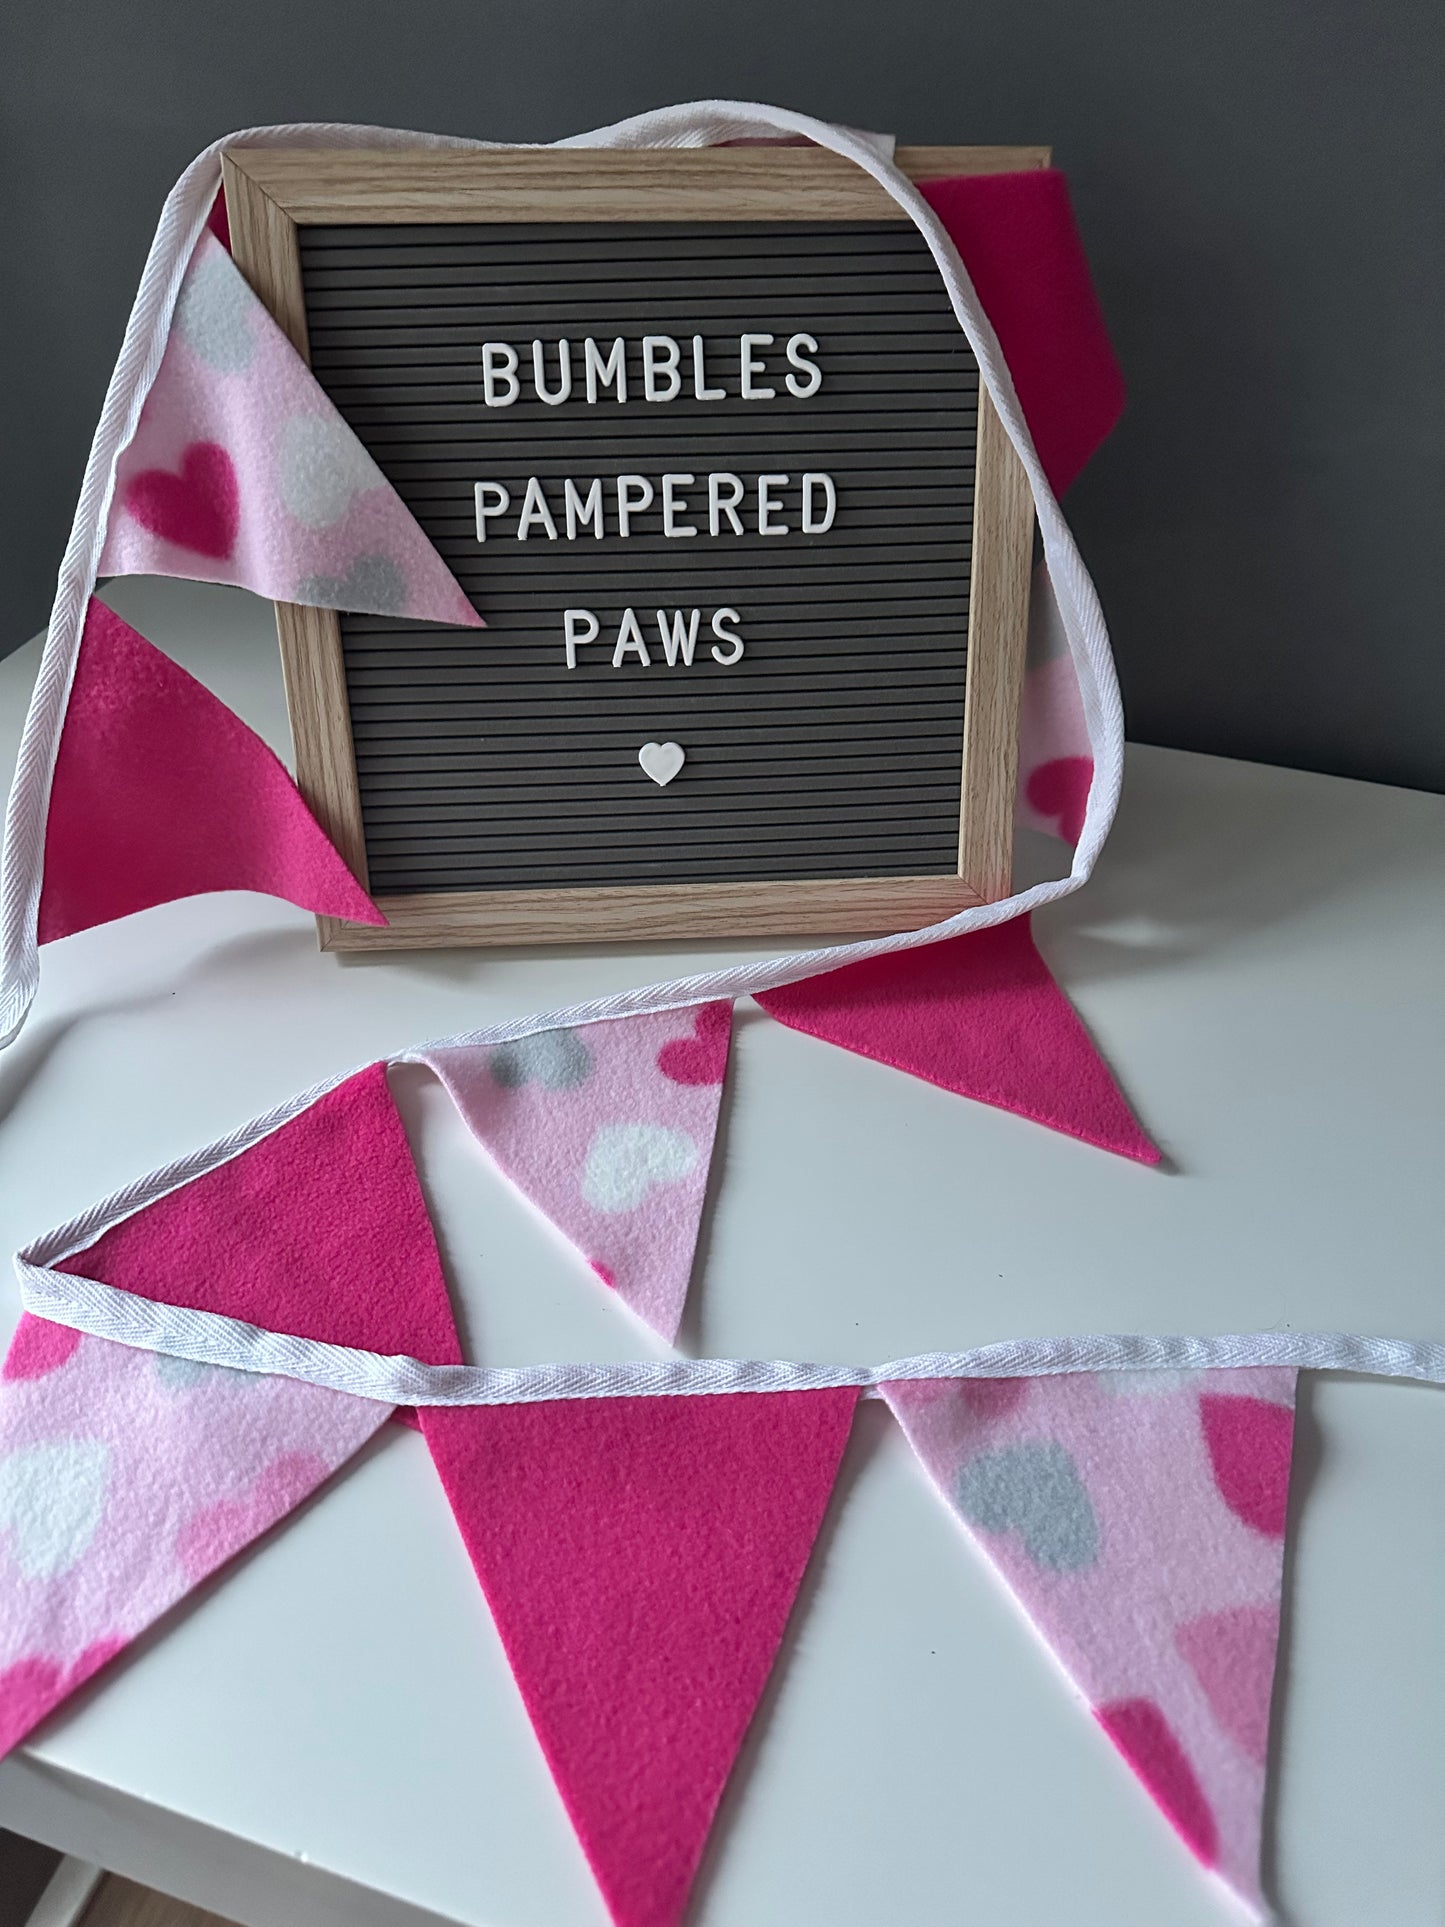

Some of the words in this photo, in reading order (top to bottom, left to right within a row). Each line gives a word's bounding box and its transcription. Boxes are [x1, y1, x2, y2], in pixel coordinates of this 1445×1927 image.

[482, 333, 822, 407] BUMBLES
[474, 473, 836, 542] PAMPERED
[564, 608, 744, 669] PAWS
